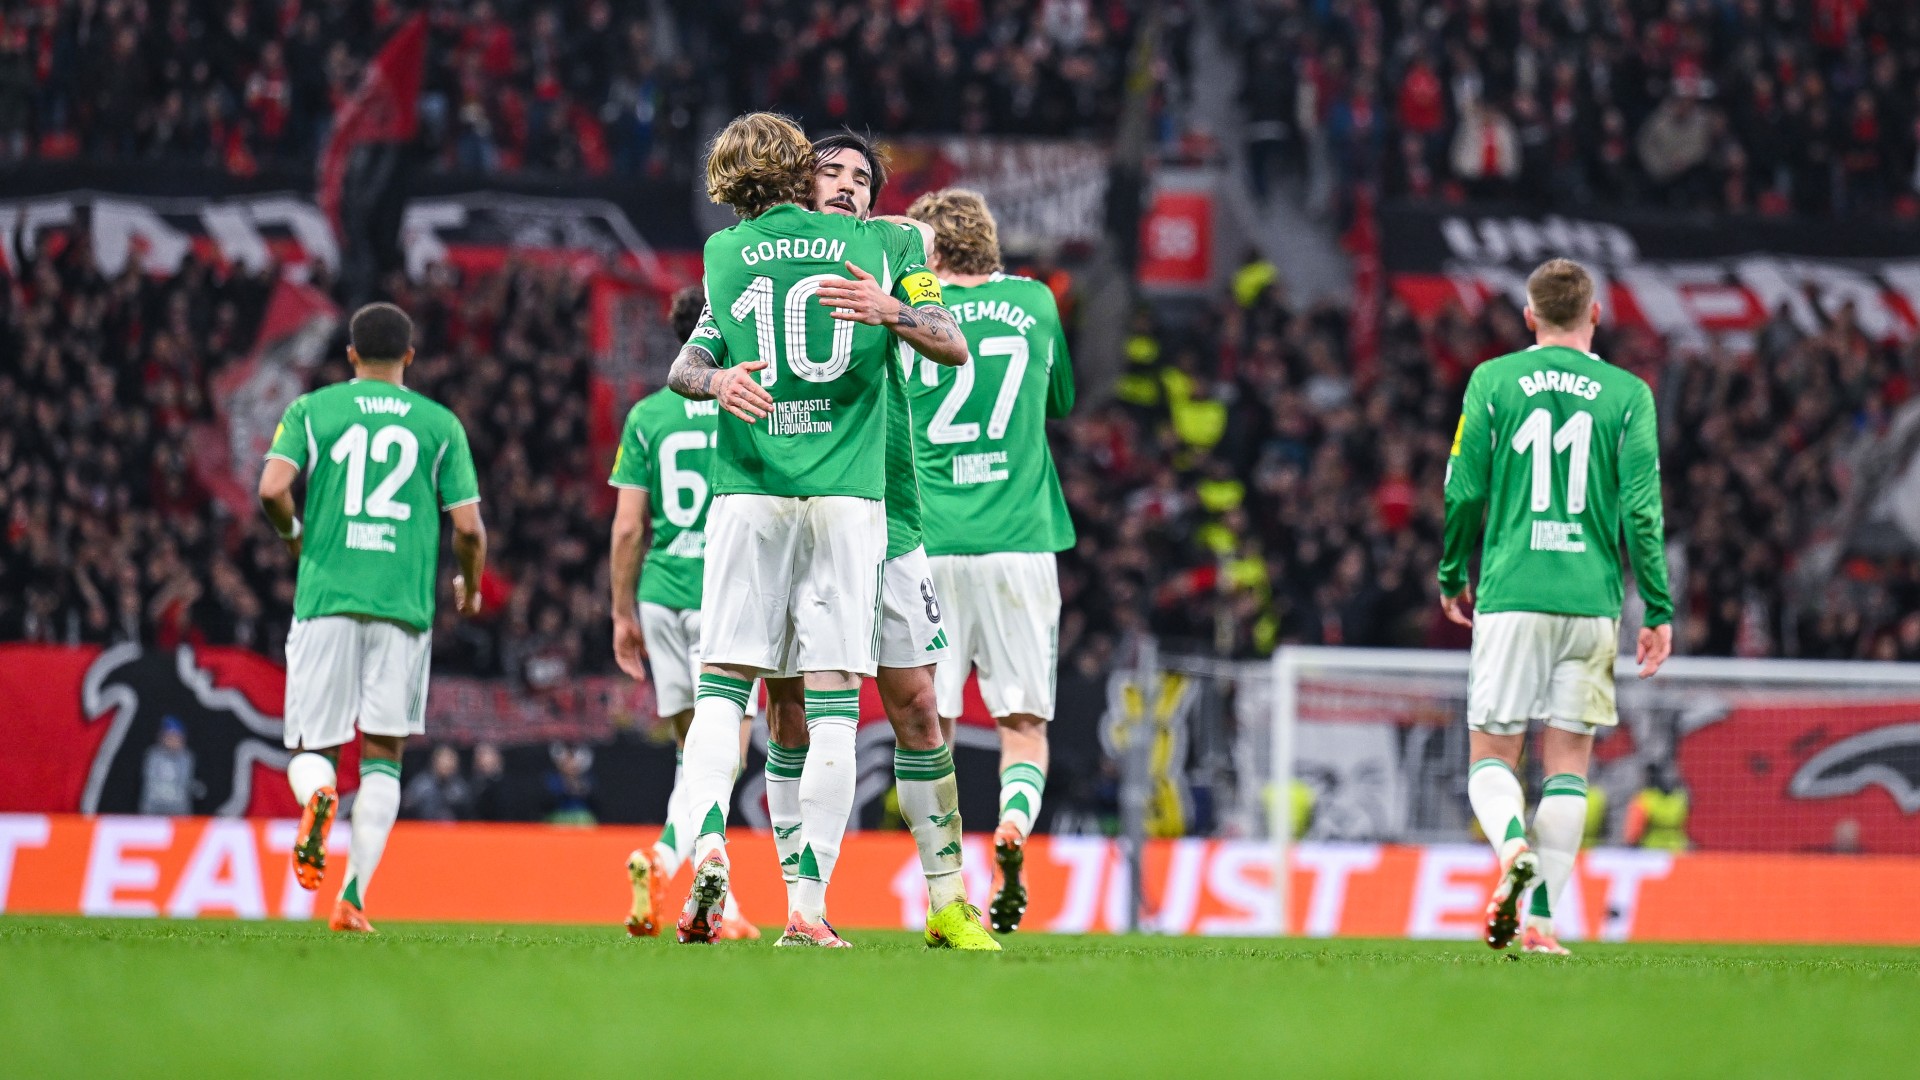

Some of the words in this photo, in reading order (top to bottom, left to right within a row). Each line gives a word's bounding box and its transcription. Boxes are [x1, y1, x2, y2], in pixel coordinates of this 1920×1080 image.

[741, 237, 846, 266] GORDON
[731, 273, 855, 387] 10
[949, 300, 1037, 336] TEMADE
[920, 335, 1029, 445] 27
[1518, 370, 1602, 400] BARNES
[354, 396, 411, 417] THIAW
[684, 400, 718, 420] MIL
[777, 399, 831, 413] NEWCASTLE
[779, 411, 811, 424] UNITED
[779, 421, 832, 435] FOUNDATION
[330, 423, 419, 521] 12
[659, 430, 717, 528] 6
[1512, 408, 1593, 514] 11
[920, 577, 941, 624] 8
[1047, 838, 1382, 936] JUST
